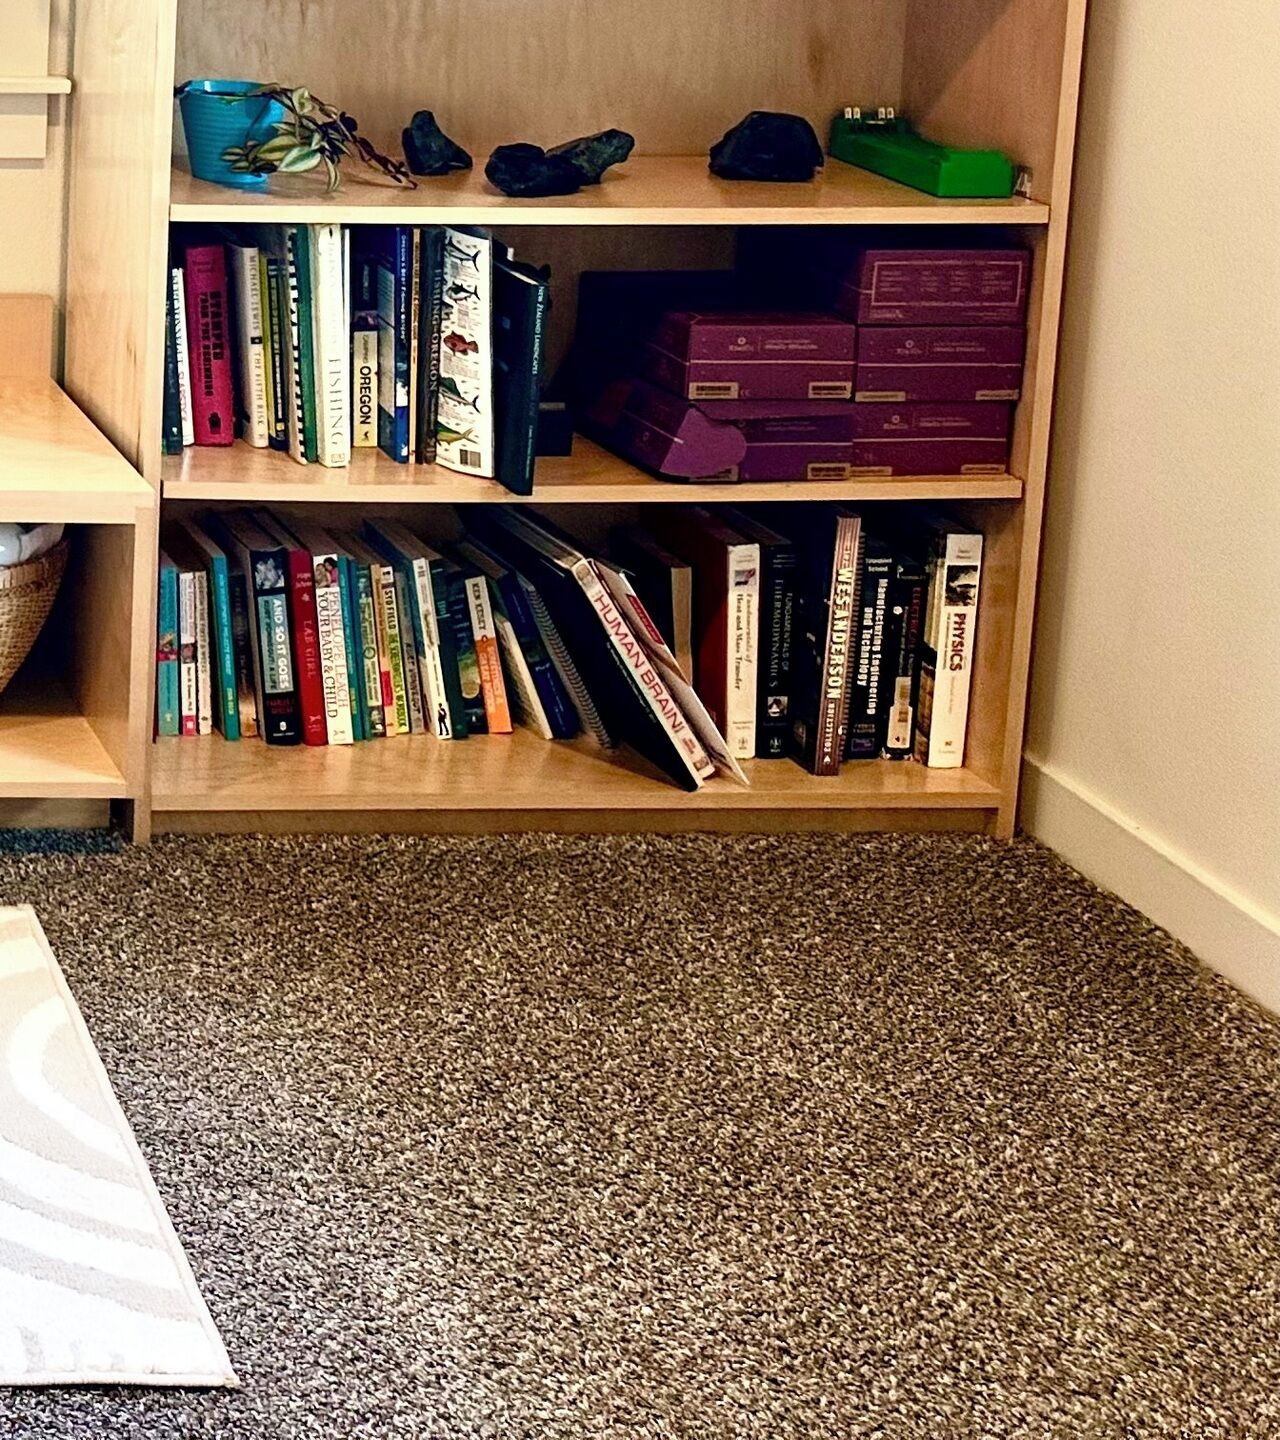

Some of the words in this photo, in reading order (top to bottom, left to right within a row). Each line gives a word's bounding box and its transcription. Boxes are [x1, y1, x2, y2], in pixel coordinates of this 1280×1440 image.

[249, 255, 260, 299] MICHAEL
[431, 269, 442, 325] FISHING
[200, 322, 211, 341] THE
[210, 291, 224, 361] STAMPED
[252, 301, 261, 331] LEWIS
[534, 303, 544, 333] ZEALAND
[254, 352, 263, 370] THE
[429, 334, 440, 391] OREGON
[531, 334, 541, 375] LANDSCAPES
[254, 373, 264, 401] FIFTH
[328, 358, 346, 445] FISHING
[359, 366, 372, 424] OREGON
[256, 404, 265, 426] RISK
[384, 590, 394, 605] SYD
[471, 582, 481, 601] KEN
[735, 593, 744, 611] Heat
[835, 568, 854, 606] WES
[273, 599, 285, 623] AND
[318, 591, 331, 627] YOUR
[387, 607, 397, 630] FIELD
[475, 604, 486, 630] KESEY
[735, 613, 743, 630] and
[745, 593, 755, 652] Fundamentals
[781, 592, 793, 659] FUNDAMENTALS
[862, 607, 874, 626] and
[871, 578, 888, 652] Manufacturing
[275, 625, 286, 642] SO
[303, 620, 314, 645] LAB
[329, 591, 345, 662] PENELOPE
[768, 578, 785, 688] THERMODYNAMICS
[949, 612, 967, 672] PHYSICS
[263, 600, 272, 620] KURT
[269, 673, 277, 690] LIFE
[276, 645, 287, 656] IT
[320, 630, 333, 663] BABY
[735, 633, 743, 654] Mass
[745, 654, 754, 663] of
[825, 609, 851, 699] ANDERSON
[856, 629, 872, 687] Technology
[278, 658, 289, 689] GOES
[305, 648, 316, 679] GIRL
[323, 665, 334, 673] &
[595, 594, 645, 670] HUMAN
[640, 670, 685, 733] BRAIN
[733, 656, 743, 690] Transfer
[782, 661, 790, 672] OF
[324, 676, 338, 718] CHILD
[336, 664, 348, 708] LEACH
[866, 654, 882, 715] Engineering
